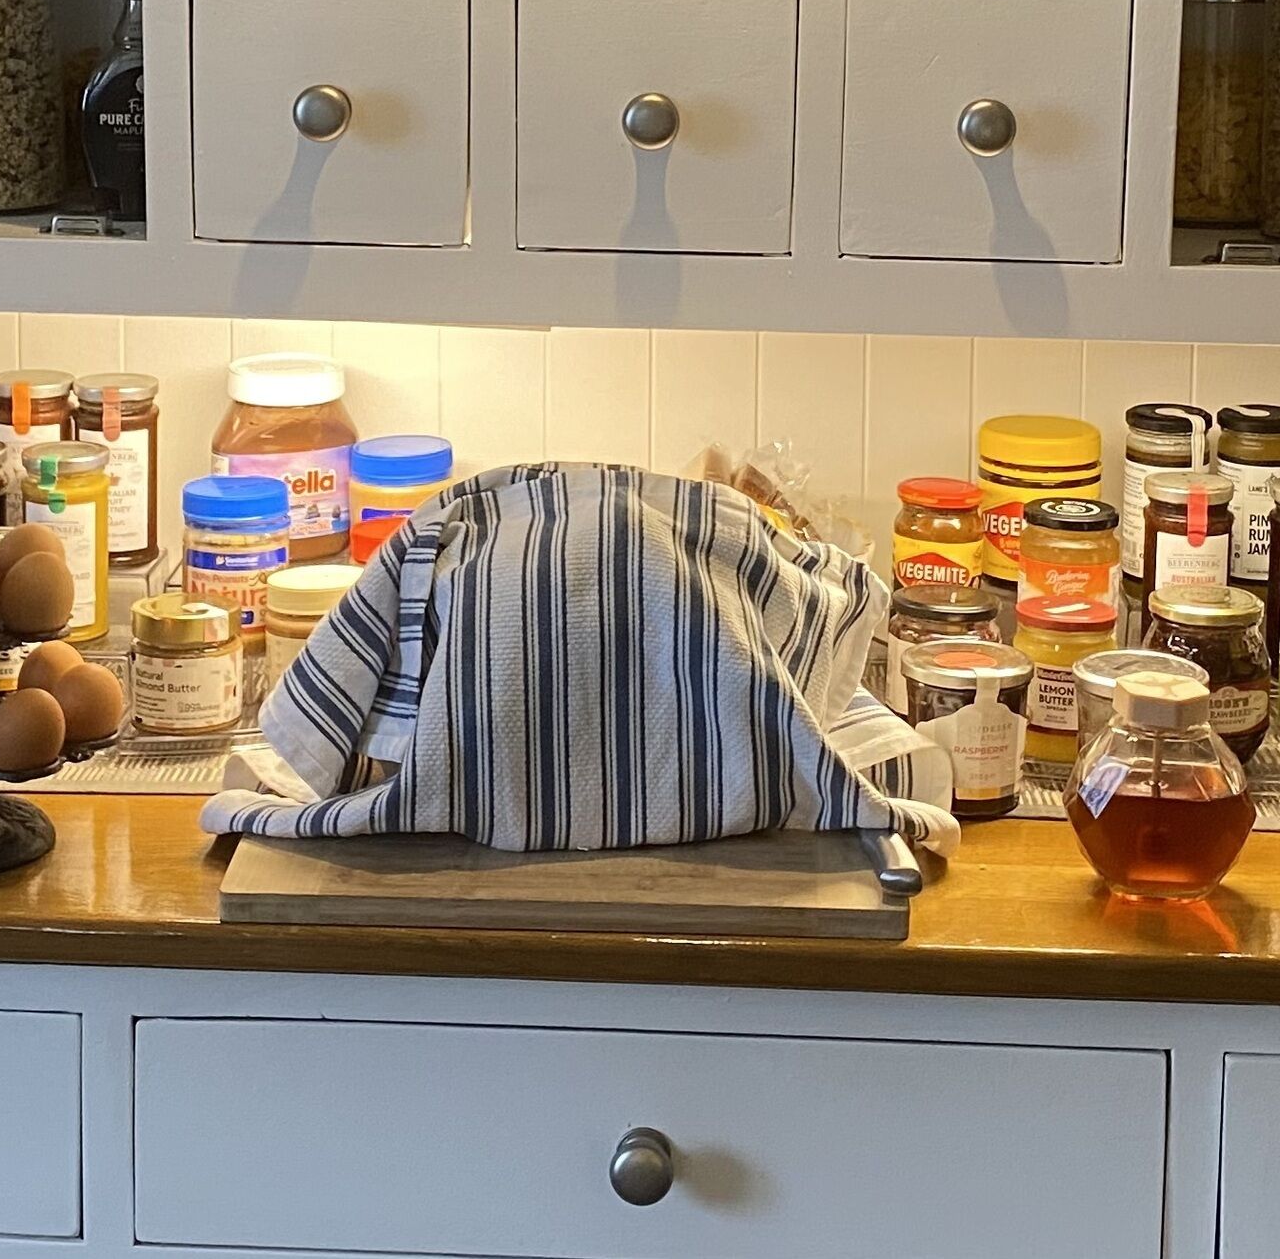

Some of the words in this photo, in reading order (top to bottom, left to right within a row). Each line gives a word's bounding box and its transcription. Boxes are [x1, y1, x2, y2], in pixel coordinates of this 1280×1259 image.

[100, 114, 131, 125] PURE
[899, 564, 966, 583] VEGEMITE
[168, 684, 201, 693] Butter
[1039, 684, 1074, 695] LEMON
[1039, 695, 1073, 706] BUTTER
